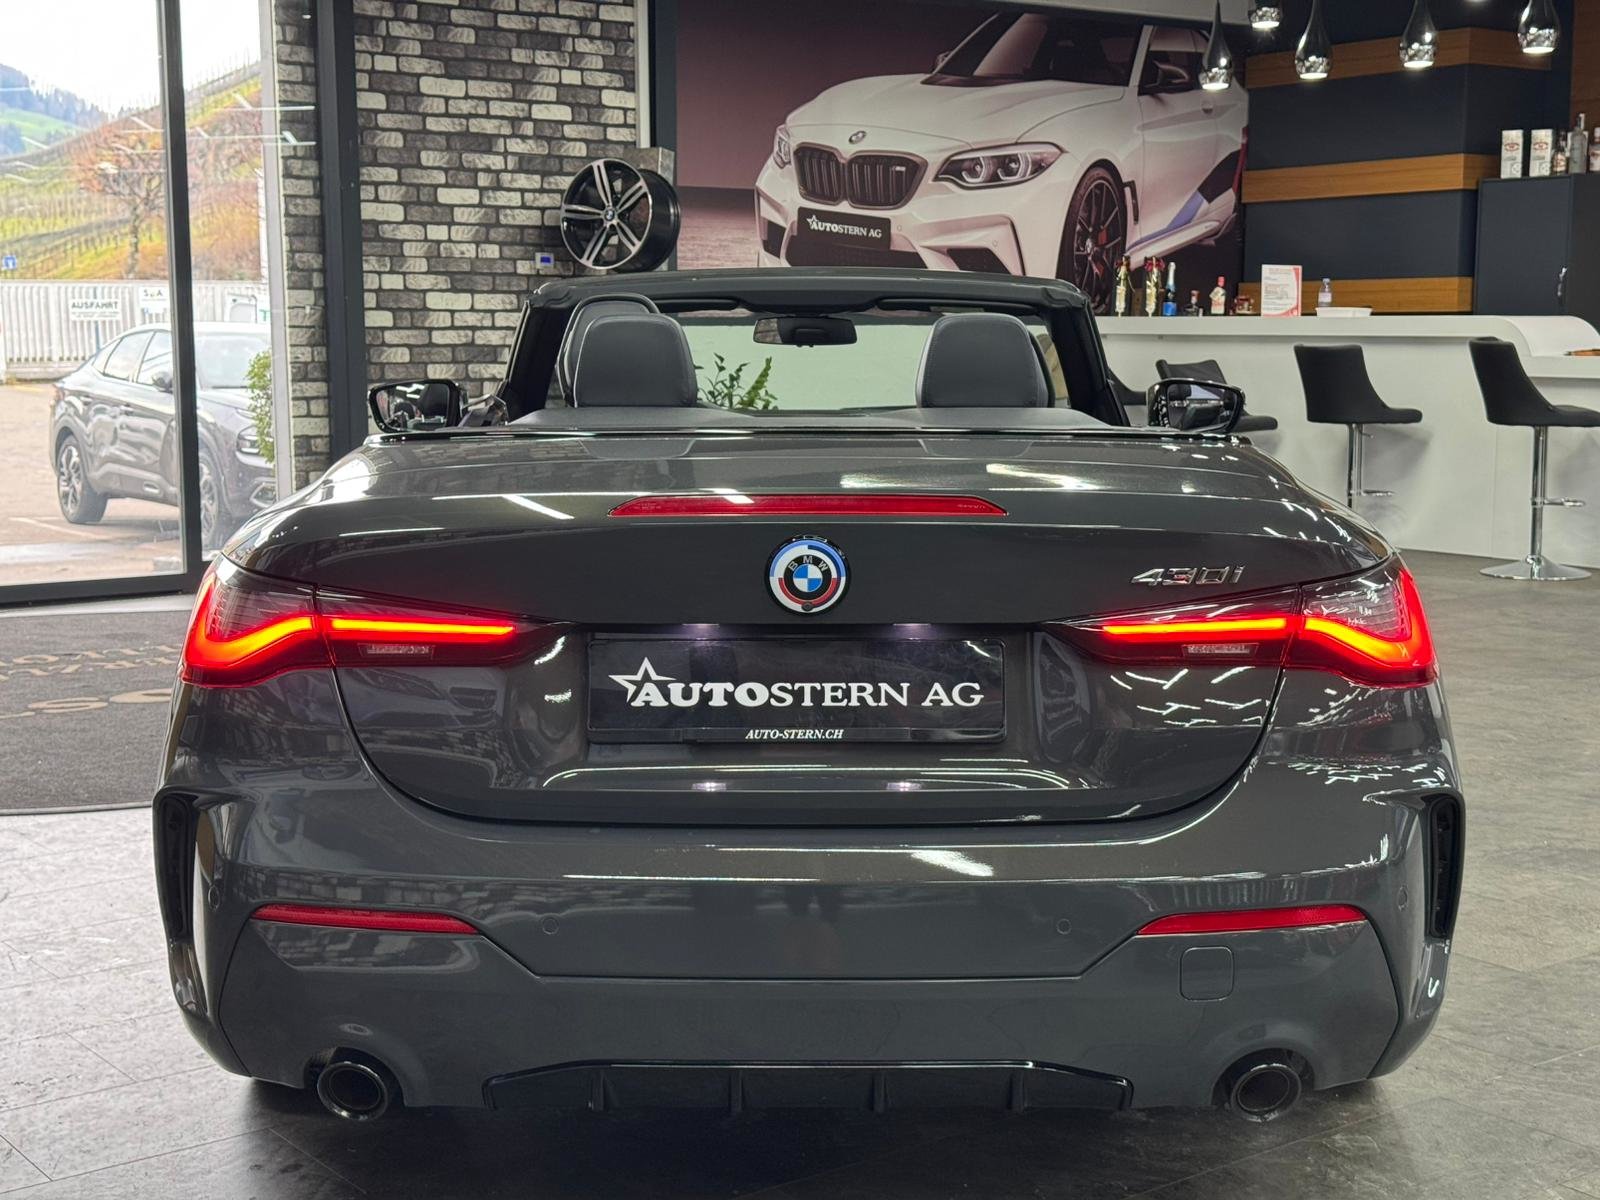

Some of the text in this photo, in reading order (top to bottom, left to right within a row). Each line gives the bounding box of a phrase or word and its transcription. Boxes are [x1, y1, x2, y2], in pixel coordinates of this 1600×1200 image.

[810, 220, 882, 238] AUTOSTERN AG
[71, 301, 118, 309] AUSFAHRT
[788, 555, 829, 572] BMW
[1131, 564, 1246, 585] 430i
[630, 681, 985, 708] AUTOSTERN AG
[745, 728, 845, 741] AUTO-STERN.CH
